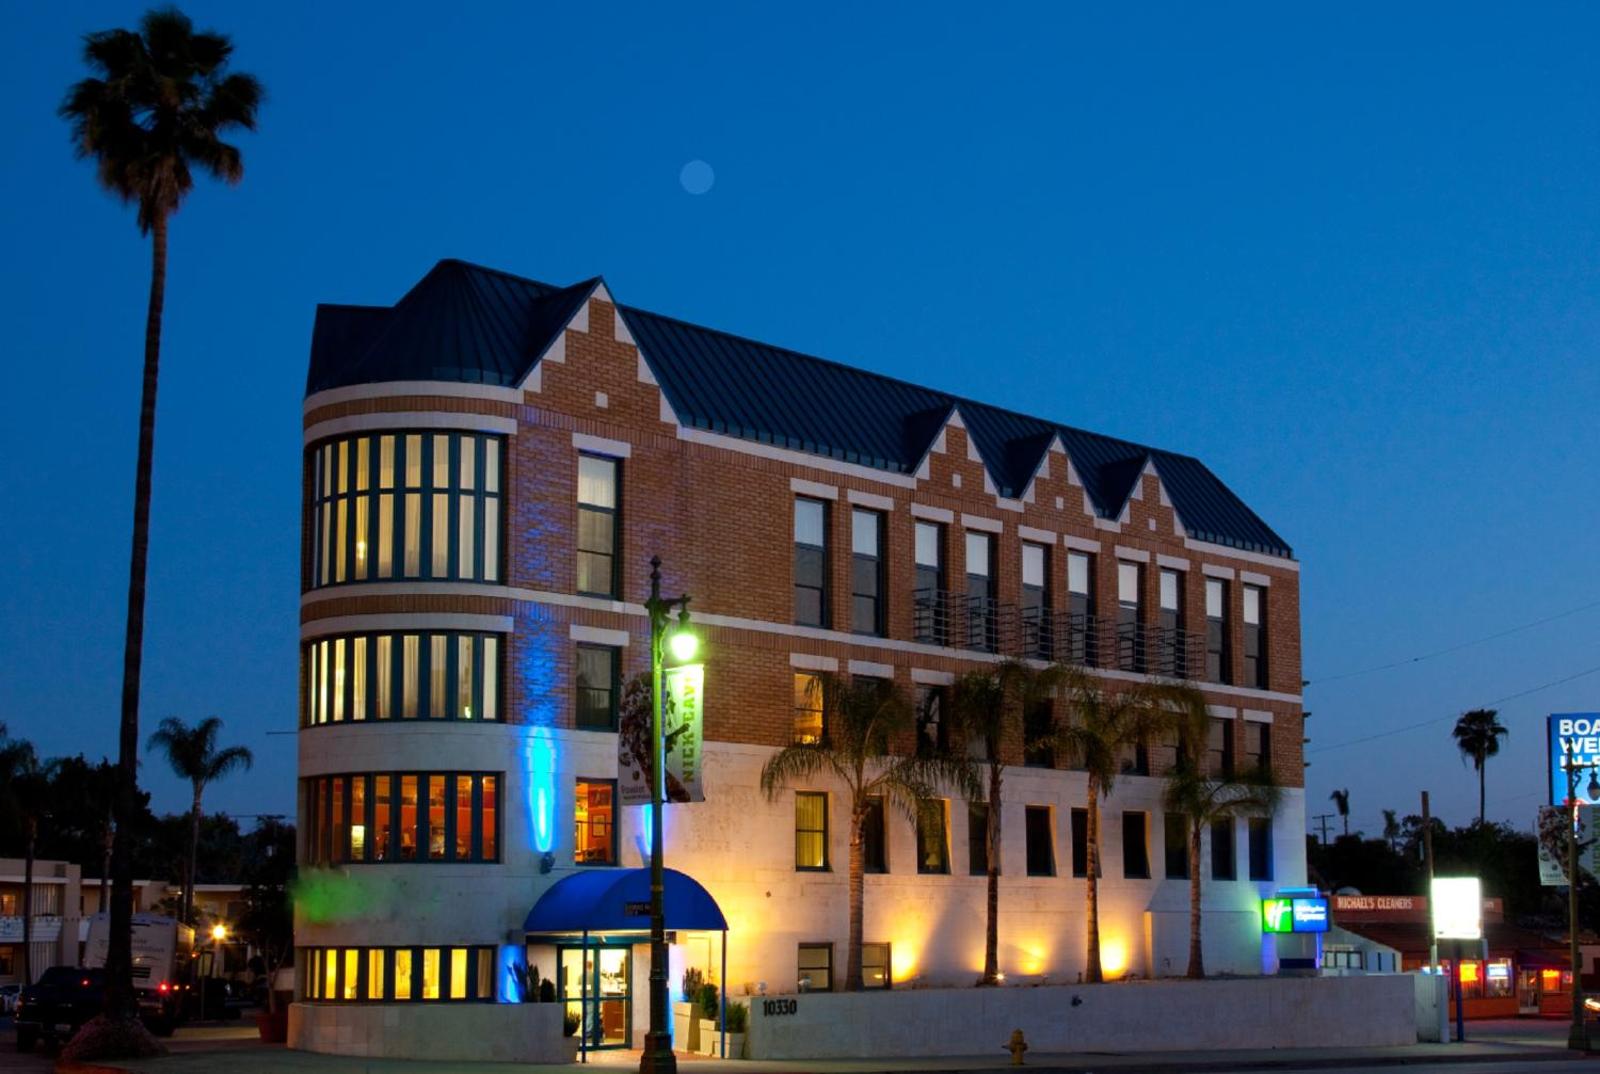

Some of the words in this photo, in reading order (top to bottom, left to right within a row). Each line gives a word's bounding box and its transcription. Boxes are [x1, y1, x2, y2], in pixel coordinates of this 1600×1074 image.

[1559, 737, 1600, 753] WE
[682, 733, 695, 783] NICK
[1337, 897, 1375, 909] MICHAEL'S
[1377, 898, 1413, 910] CLEANERS
[763, 999, 797, 1017] 10330
